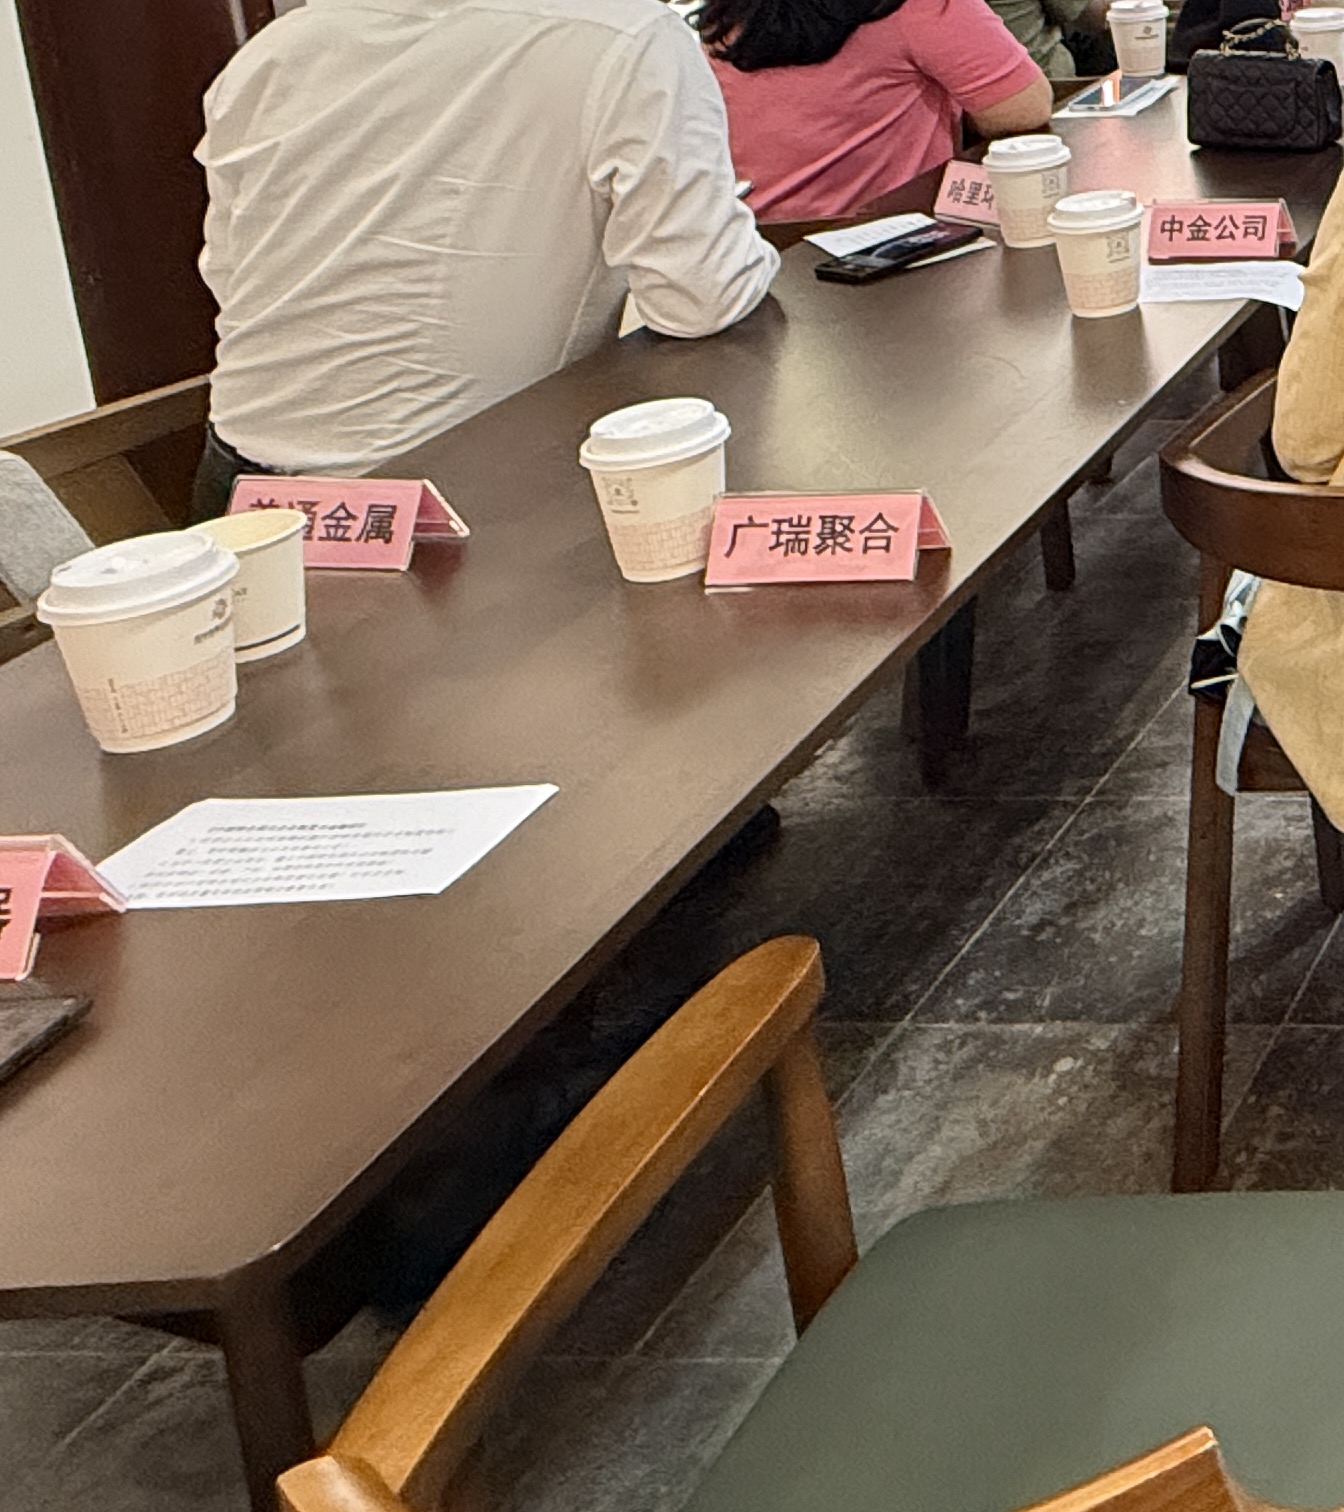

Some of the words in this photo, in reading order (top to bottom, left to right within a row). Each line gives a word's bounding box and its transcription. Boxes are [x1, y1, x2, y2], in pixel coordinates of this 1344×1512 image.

[1159, 214, 1268, 243] 中金公司
[724, 511, 900, 558] 广瑞聚合
